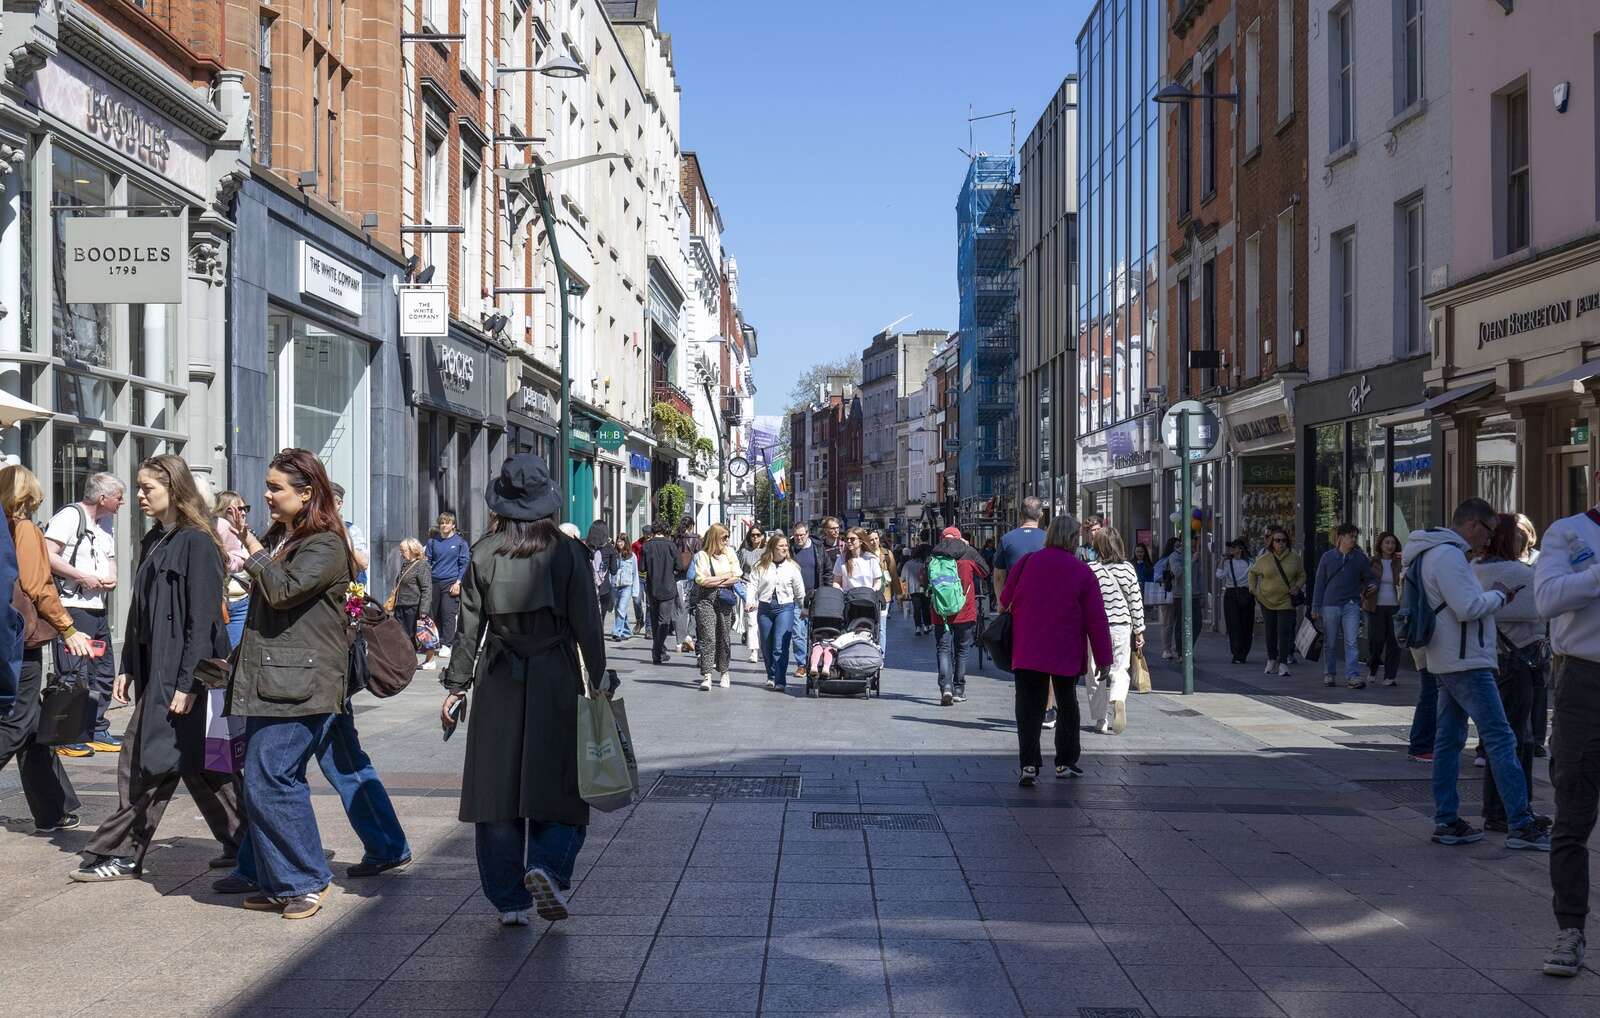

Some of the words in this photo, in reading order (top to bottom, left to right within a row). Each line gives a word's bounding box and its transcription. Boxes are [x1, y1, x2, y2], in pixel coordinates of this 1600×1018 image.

[89, 87, 170, 160] BOODLES
[74, 247, 170, 262] BOODLES
[109, 265, 137, 275] 1798
[310, 256, 320, 275] THE
[321, 262, 337, 283] WHITE
[338, 270, 360, 293] COMPANY
[1477, 318, 1508, 350] JOHN
[1509, 299, 1571, 336] BRERETON
[1575, 291, 1600, 318] JEWE
[441, 344, 474, 383] ROCKS
